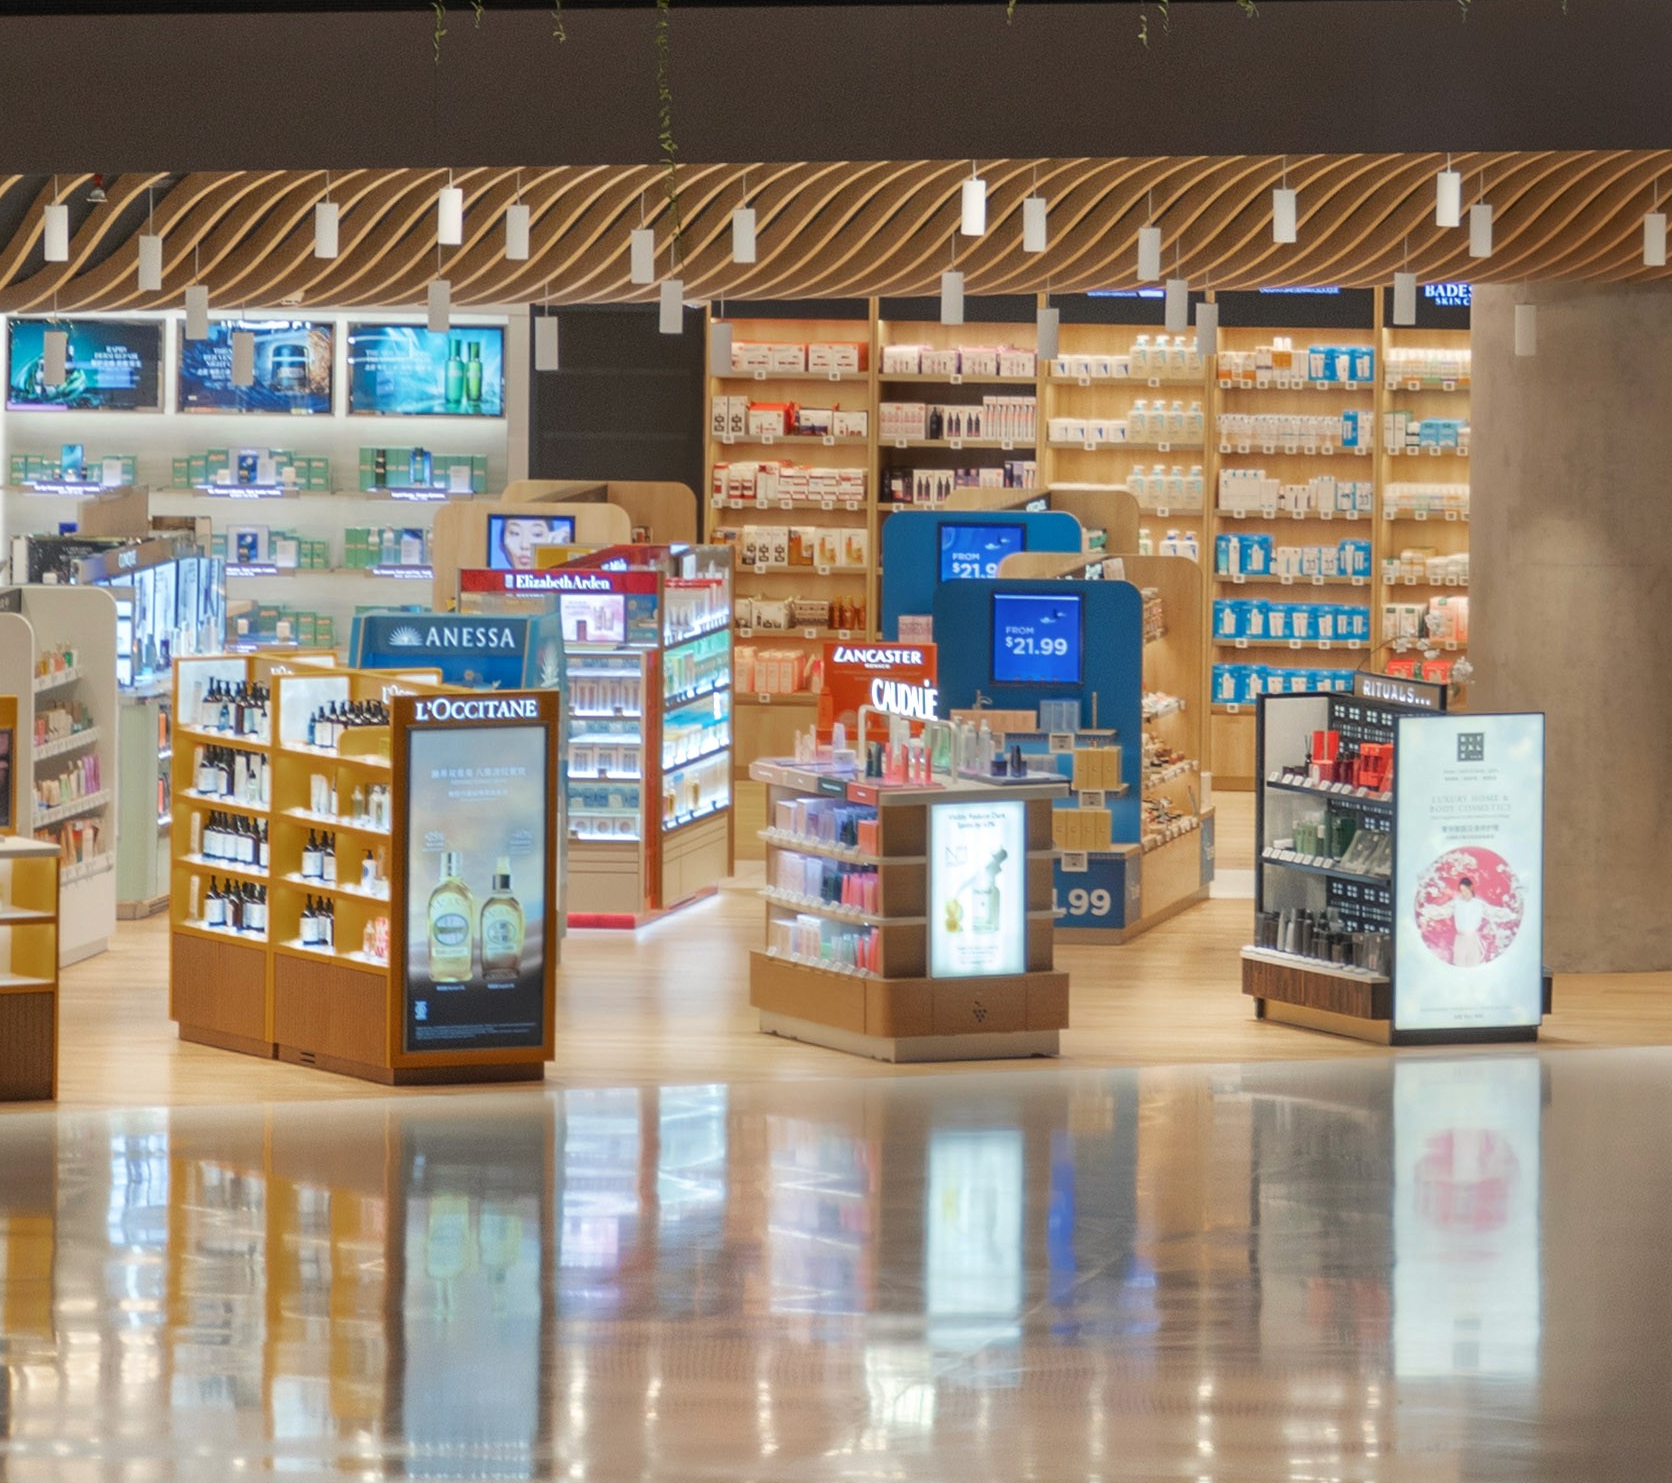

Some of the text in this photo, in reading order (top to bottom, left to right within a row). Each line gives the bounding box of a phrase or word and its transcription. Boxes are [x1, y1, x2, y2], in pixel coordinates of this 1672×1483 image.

[1424, 283, 1473, 298] BADES
[952, 553, 980, 561] FROM
[952, 562, 998, 579] $21.9
[425, 626, 516, 649] ANESSA
[1005, 626, 1034, 635] FROM
[1005, 636, 1068, 656] $21.99
[833, 646, 923, 665] LANCASTER
[415, 698, 538, 721] L'OCCITANE
